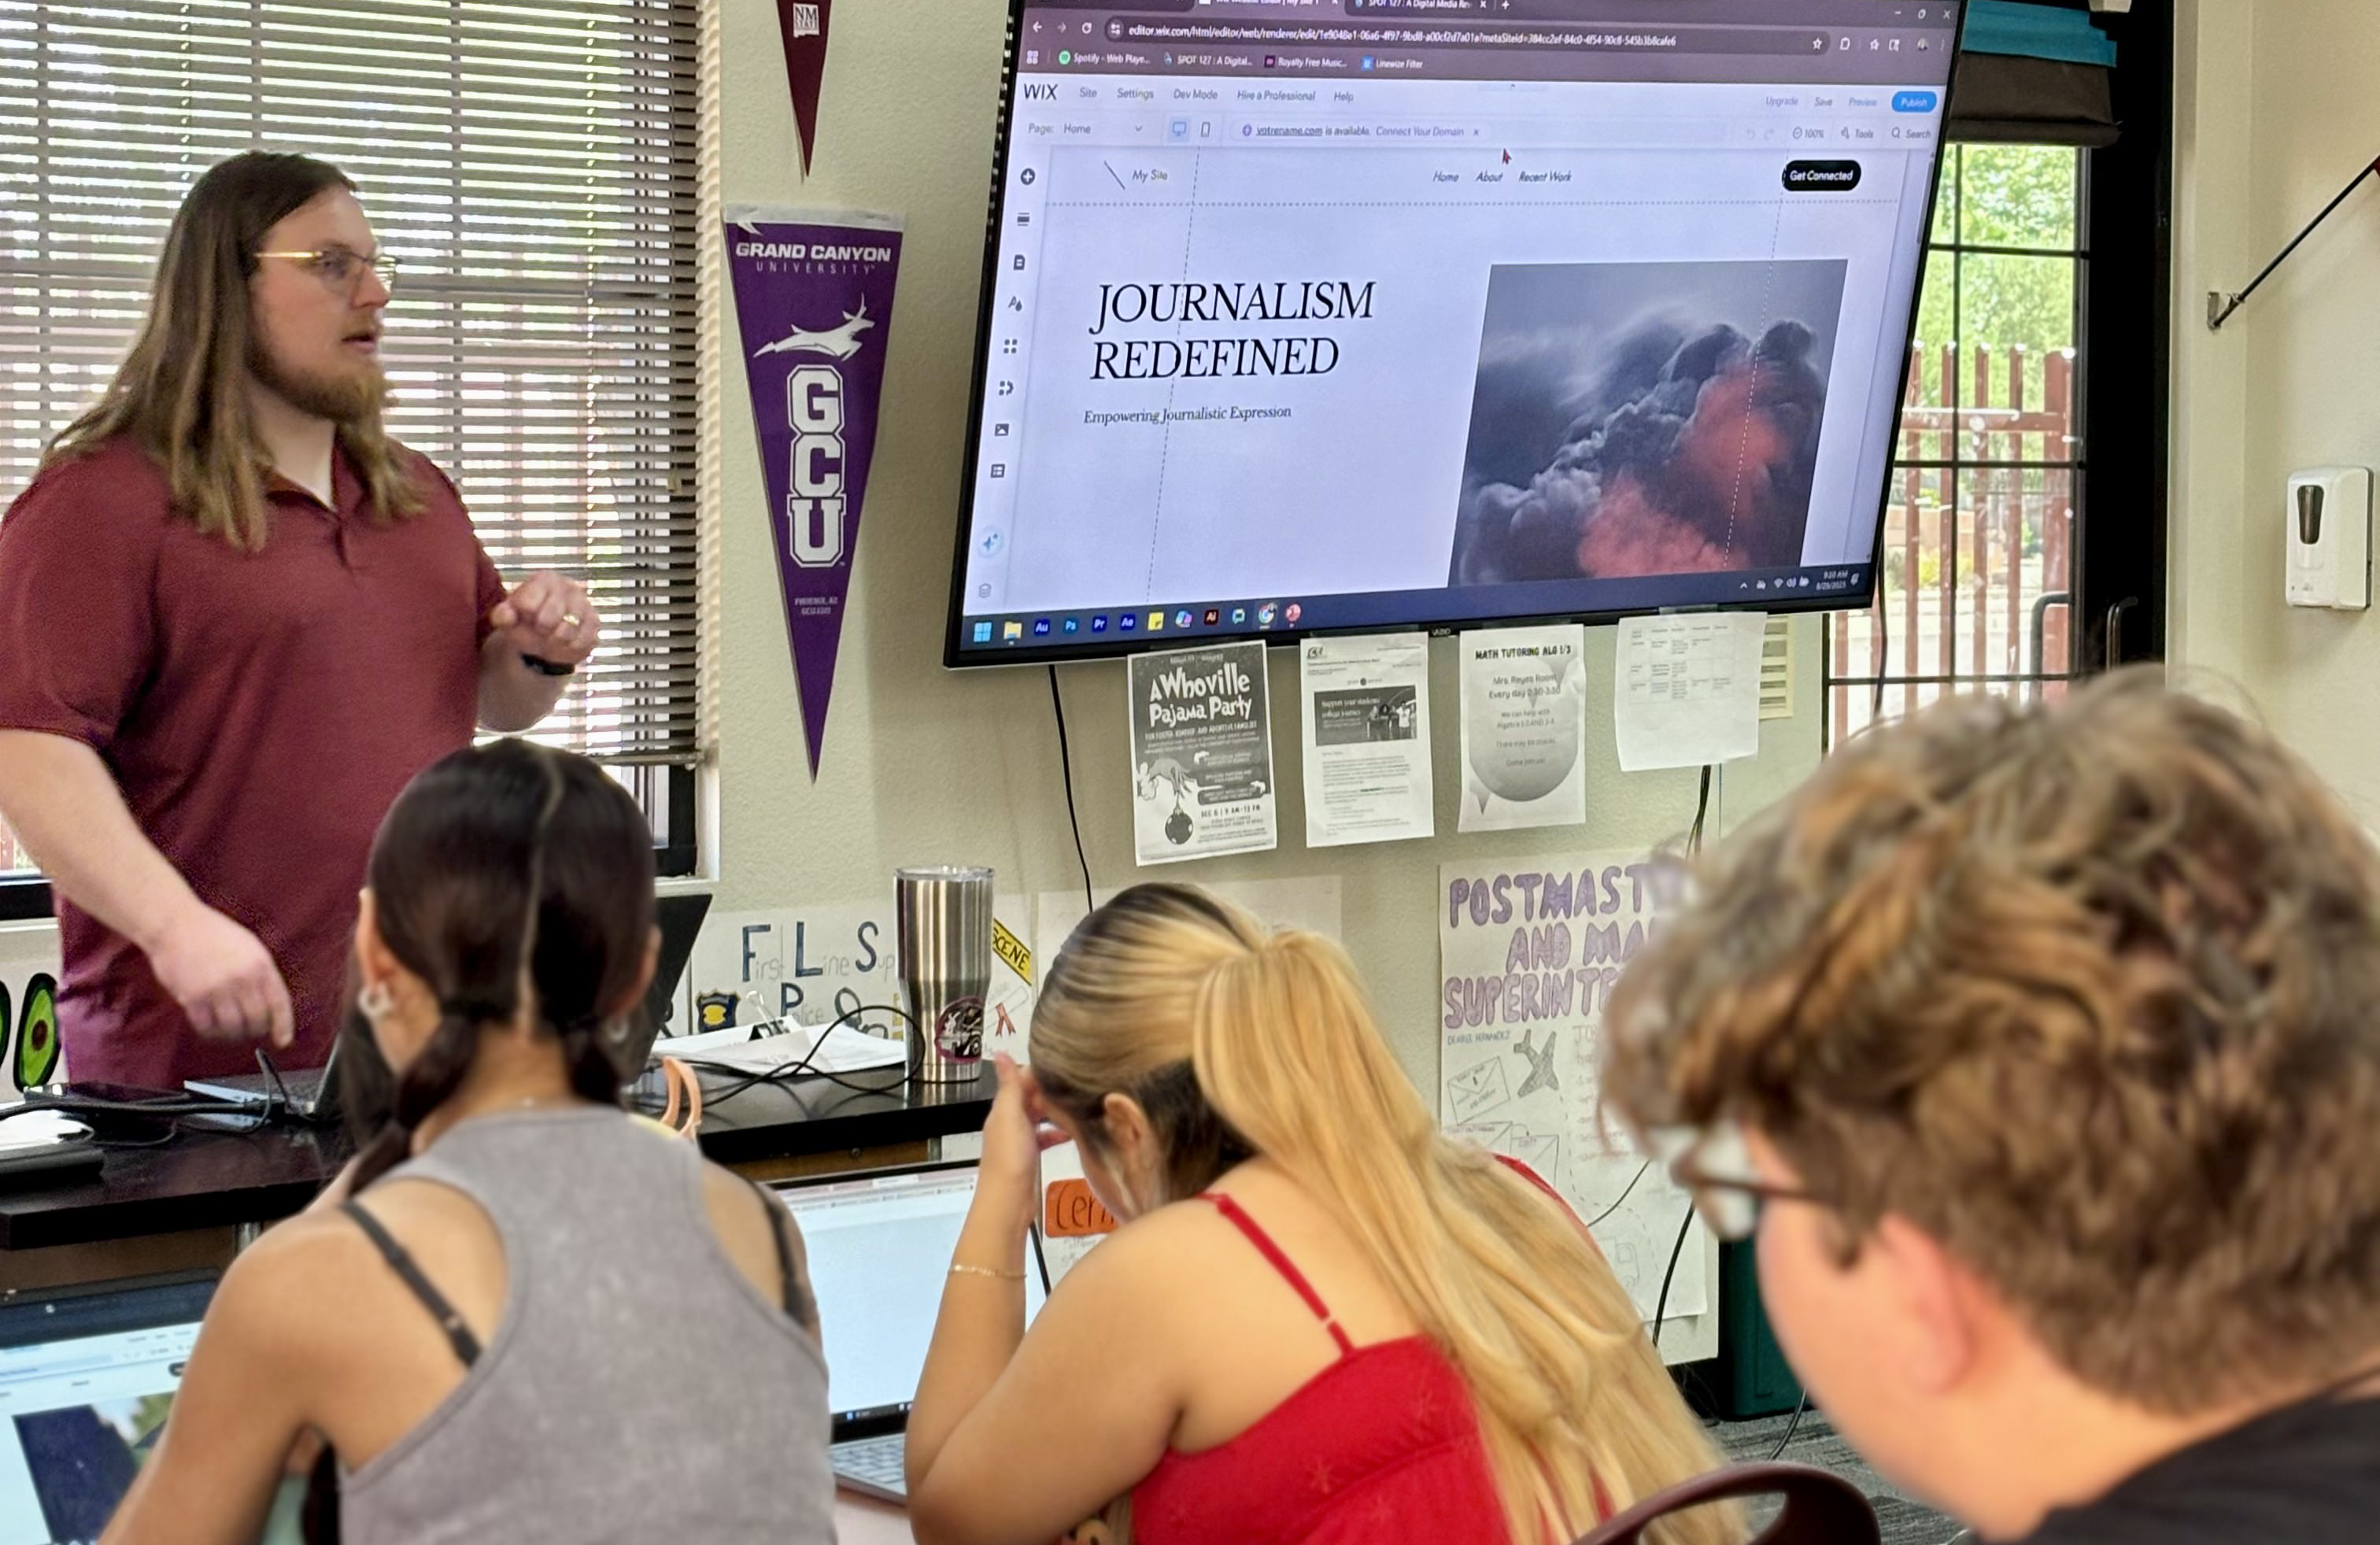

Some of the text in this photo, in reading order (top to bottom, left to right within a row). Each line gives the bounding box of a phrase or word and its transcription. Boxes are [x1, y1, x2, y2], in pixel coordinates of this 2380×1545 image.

[1074, 52, 1100, 65] Spotify
[1107, 54, 1123, 63] Web
[1177, 54, 1196, 65] SPOT
[1199, 55, 1211, 65] 127
[1278, 57, 1303, 68] Royalty
[1305, 57, 1321, 67] Free
[1406, 59, 1423, 68] Filter
[1023, 83, 1058, 101] WIX
[1079, 87, 1097, 98] Site
[1117, 88, 1154, 101] Settings
[1173, 88, 1218, 100] Dev Mode
[1237, 91, 1255, 101] Hire
[1263, 91, 1315, 102] Professional
[1334, 91, 1354, 103] Help
[1766, 96, 1798, 108] Upgrade
[1814, 97, 1832, 107] Save
[1849, 98, 1877, 107] Preview
[1901, 97, 1927, 108] Publish
[1028, 123, 1091, 134] Page: Home
[1376, 127, 1411, 137] Connect
[1413, 127, 1432, 137] Your
[1433, 127, 1464, 137] Domain
[1805, 128, 1824, 139] 100%
[1855, 129, 1874, 139] Tools
[1906, 129, 1931, 139] Search
[1132, 168, 1168, 183] My Site
[1432, 170, 1459, 183] Home
[1476, 170, 1503, 183] About
[1518, 170, 1572, 183] Recent Work
[1789, 168, 1853, 182] Get Connected
[736, 241, 891, 262] GRAND CANYON
[756, 261, 870, 275] UNIVERSITY
[1088, 279, 1377, 335] JOURNALISM
[1089, 337, 1340, 380] REDEFINED
[1083, 406, 1292, 426] Empowering Journalistic Expression
[791, 367, 844, 564] GCU
[1475, 649, 1499, 660] MATH
[1501, 646, 1539, 658] TUTORING
[1149, 662, 1251, 702] A Whoville
[1511, 689, 1526, 699] day
[1149, 694, 1253, 728] Pajama Party
[1449, 864, 1662, 930] POSTMAST
[855, 920, 896, 984] Sup
[1505, 918, 1653, 974] AND MA
